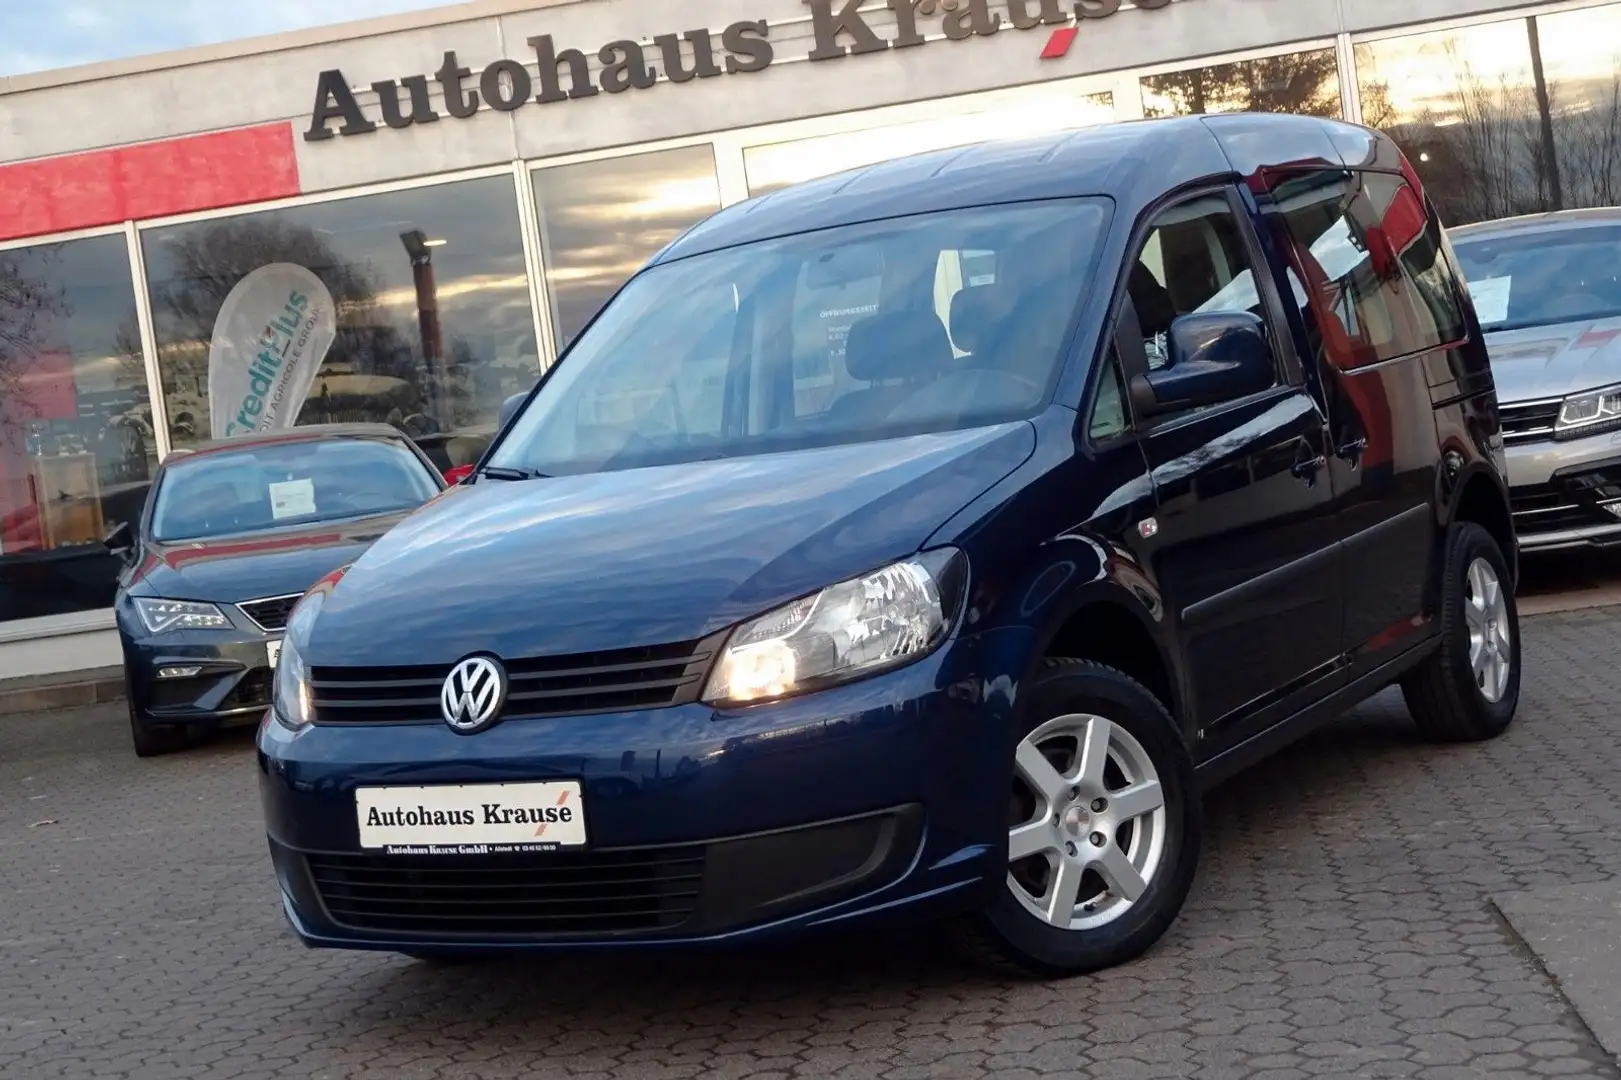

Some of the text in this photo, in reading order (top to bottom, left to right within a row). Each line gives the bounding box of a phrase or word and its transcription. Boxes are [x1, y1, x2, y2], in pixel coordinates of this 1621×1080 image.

[303, 0, 1172, 141] Autohaus Krau
[271, 351, 302, 413] AGRICOLE
[443, 659, 499, 727] VW
[366, 803, 573, 826] Autohaus Krause
[387, 845, 428, 854] Autohaus
[458, 845, 488, 854] GmbH
